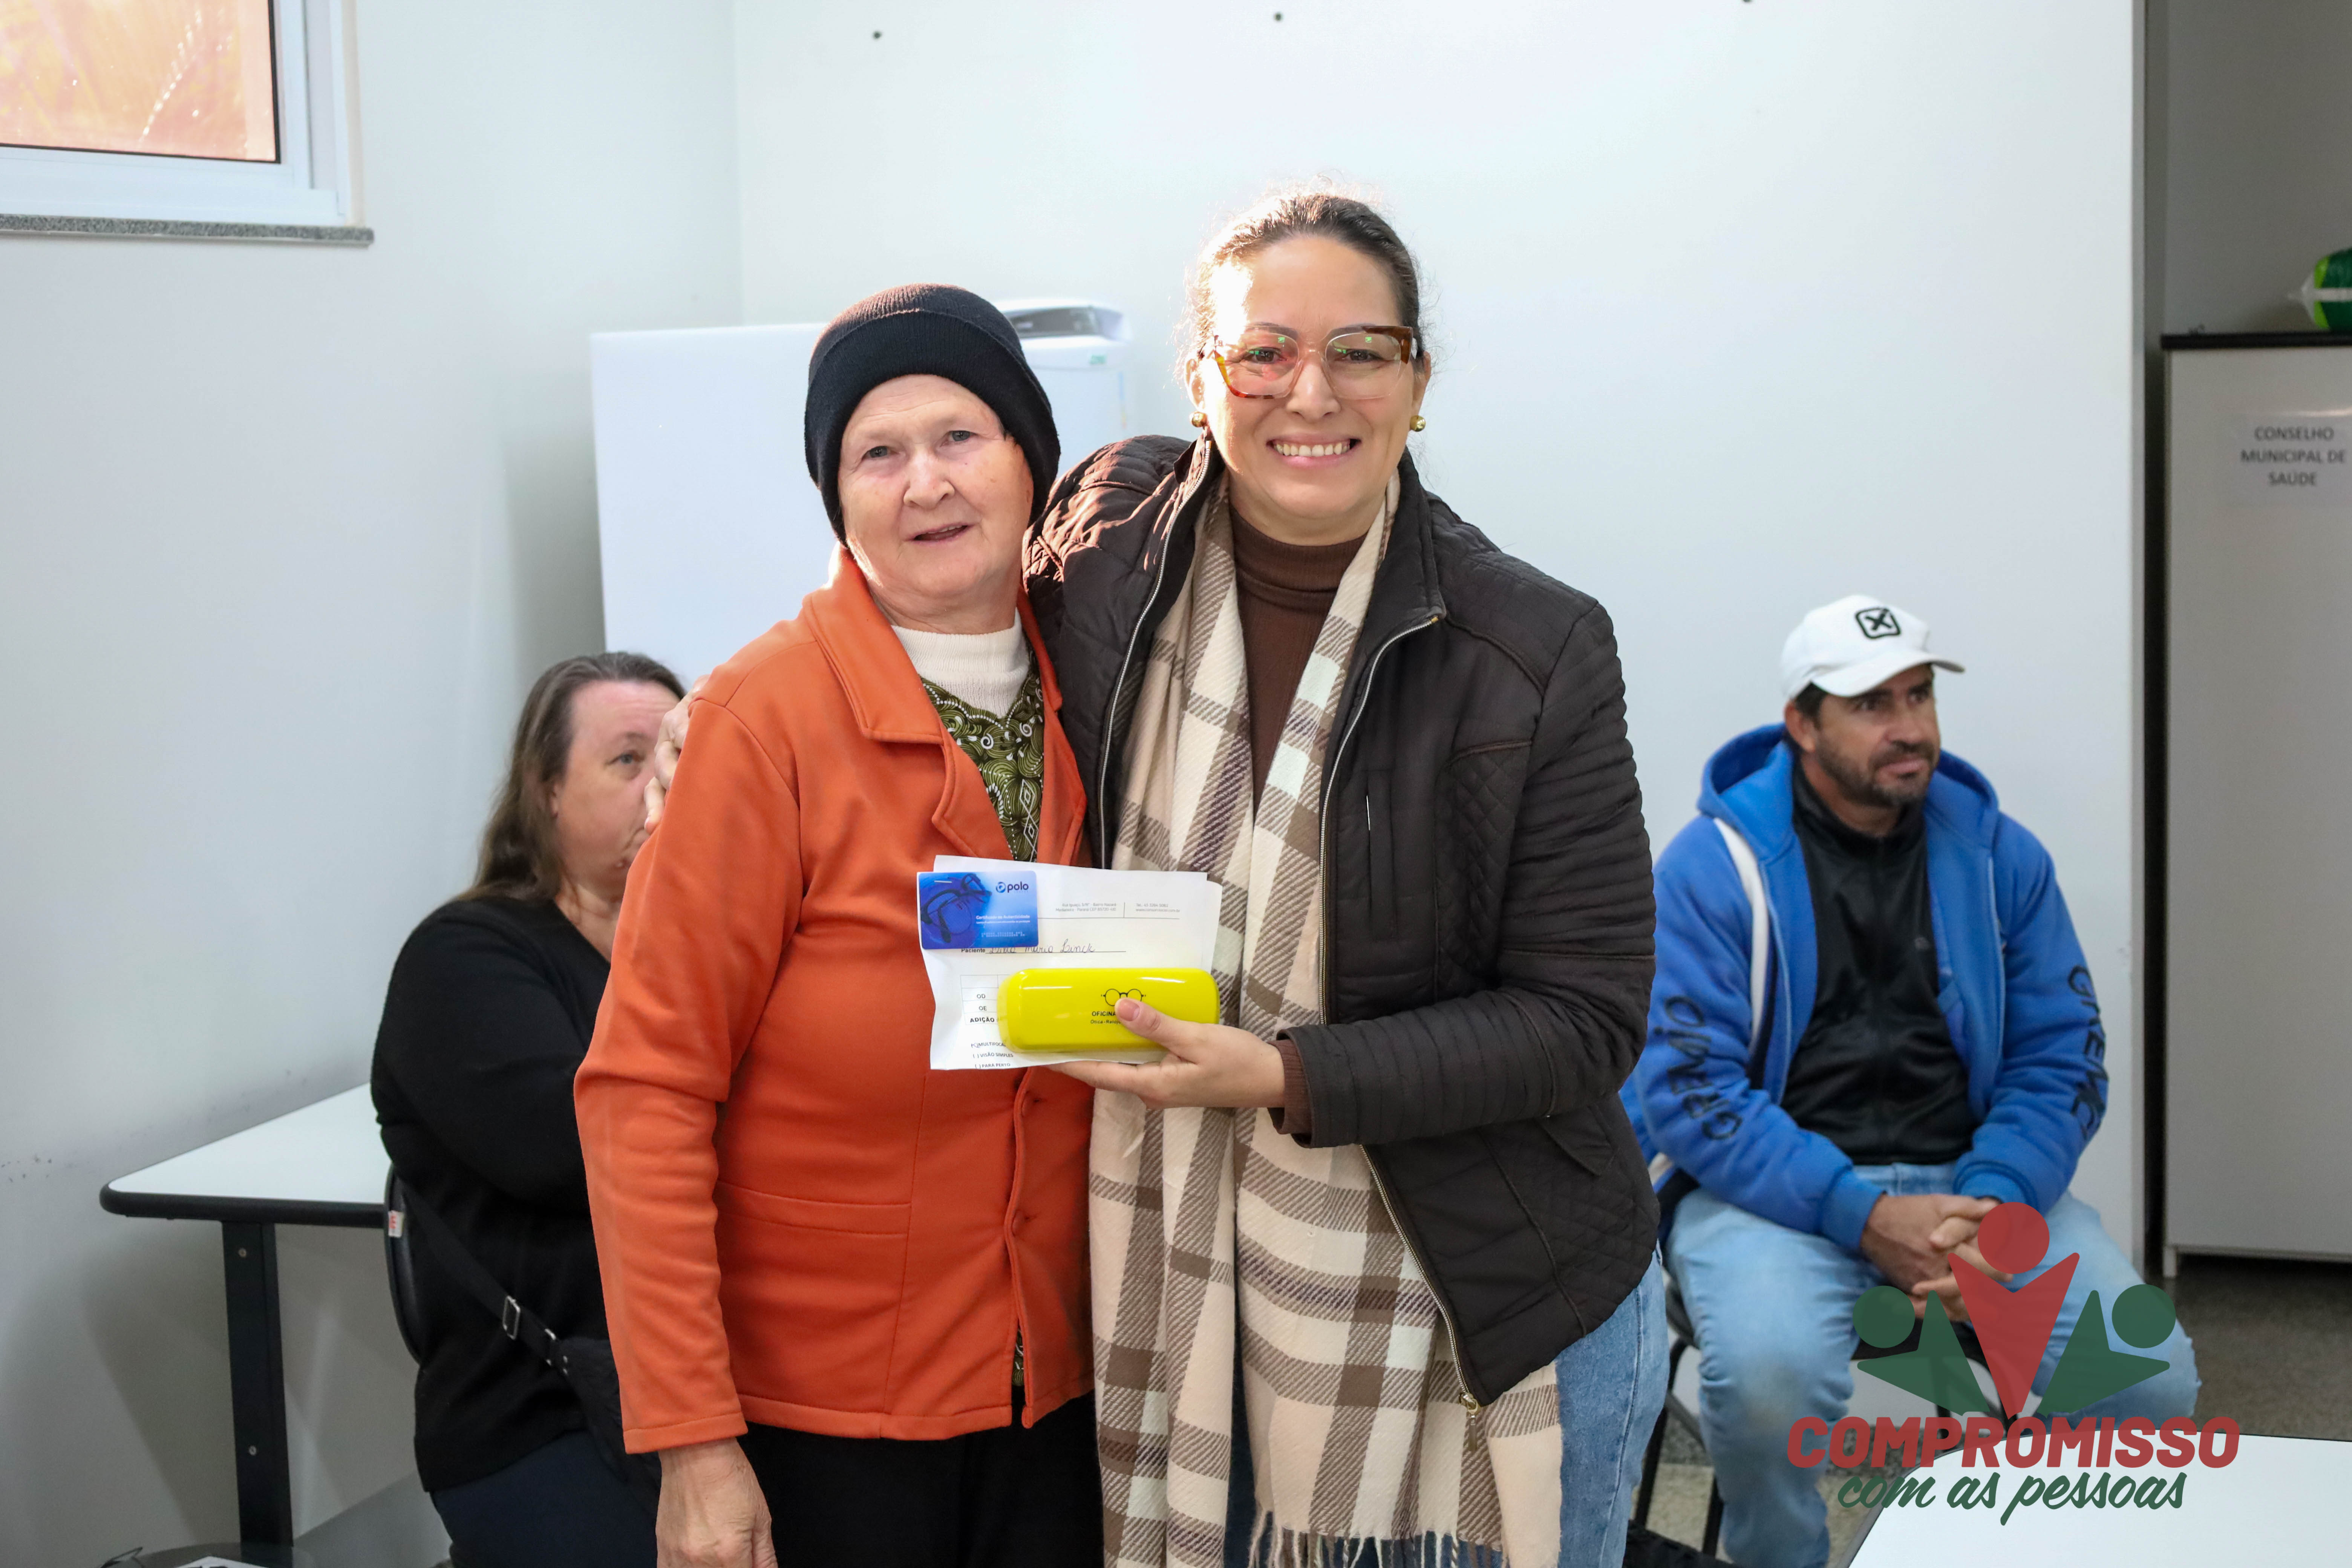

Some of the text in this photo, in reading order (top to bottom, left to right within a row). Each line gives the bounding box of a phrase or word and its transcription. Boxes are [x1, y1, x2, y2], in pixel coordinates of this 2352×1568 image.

[2254, 426, 2334, 441] CONSELHO
[2240, 450, 2346, 463] MUNICIPAL DE
[1008, 881, 1029, 893] polo
